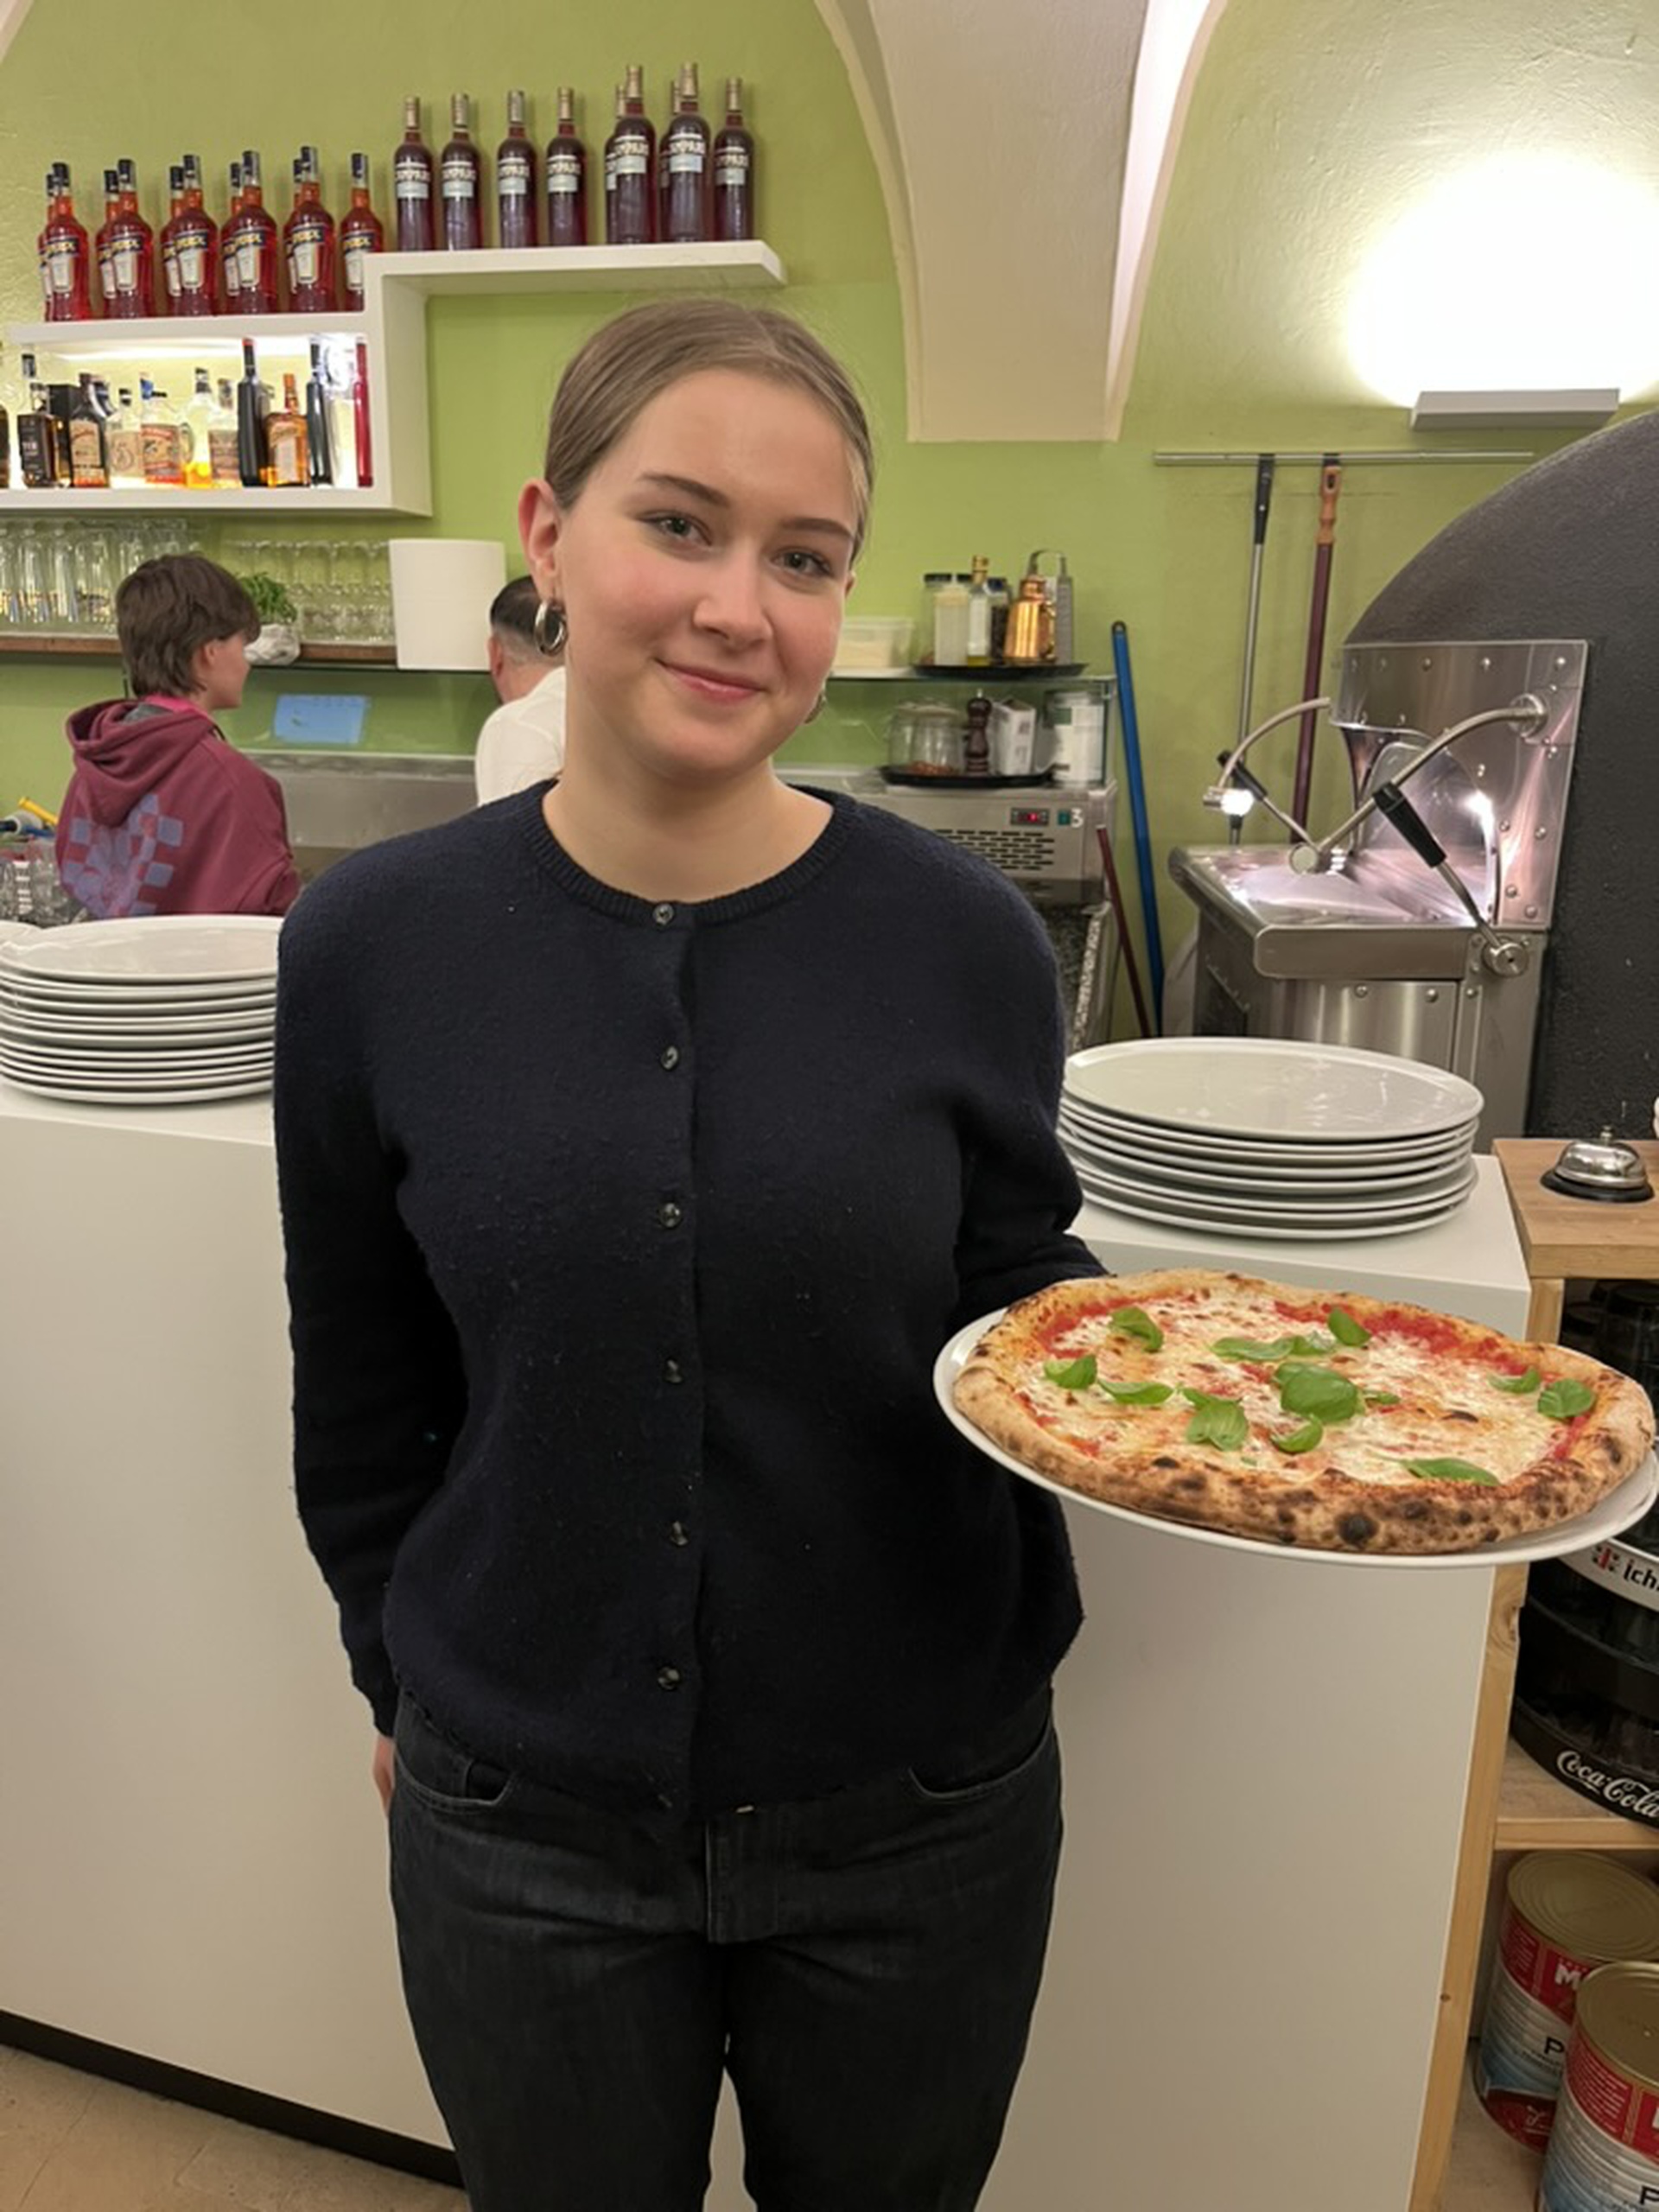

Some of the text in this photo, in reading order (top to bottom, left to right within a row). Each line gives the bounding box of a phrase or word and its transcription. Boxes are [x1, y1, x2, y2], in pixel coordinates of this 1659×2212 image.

[1071, 807, 1084, 828] 3
[1624, 1558, 1659, 1592] ich
[1557, 1751, 1659, 1818] Coca-Cola
